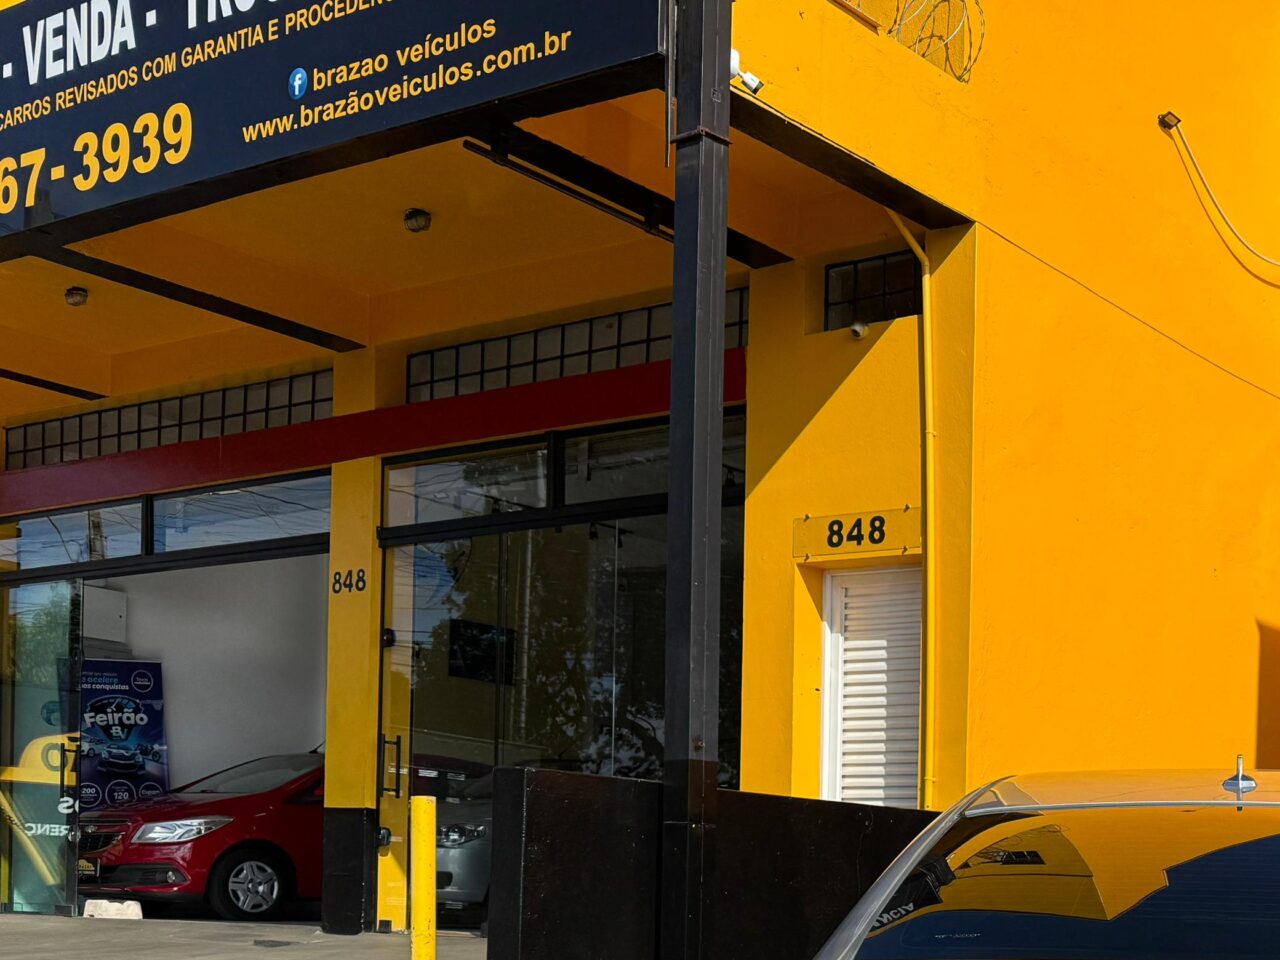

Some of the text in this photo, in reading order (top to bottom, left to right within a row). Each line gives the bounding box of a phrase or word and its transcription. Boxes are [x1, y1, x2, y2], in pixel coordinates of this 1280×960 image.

[22, 0, 136, 85] VENDA
[312, 53, 389, 91] brazao
[396, 18, 497, 67] veículos
[55, 66, 138, 111] REVISADOS
[142, 52, 176, 82] COM
[181, 24, 264, 68] GARANTIA
[268, 19, 279, 40] E
[826, 515, 886, 548] 848
[332, 568, 366, 594] 848
[83, 708, 149, 728] Feirão
[113, 791, 129, 799] 120
